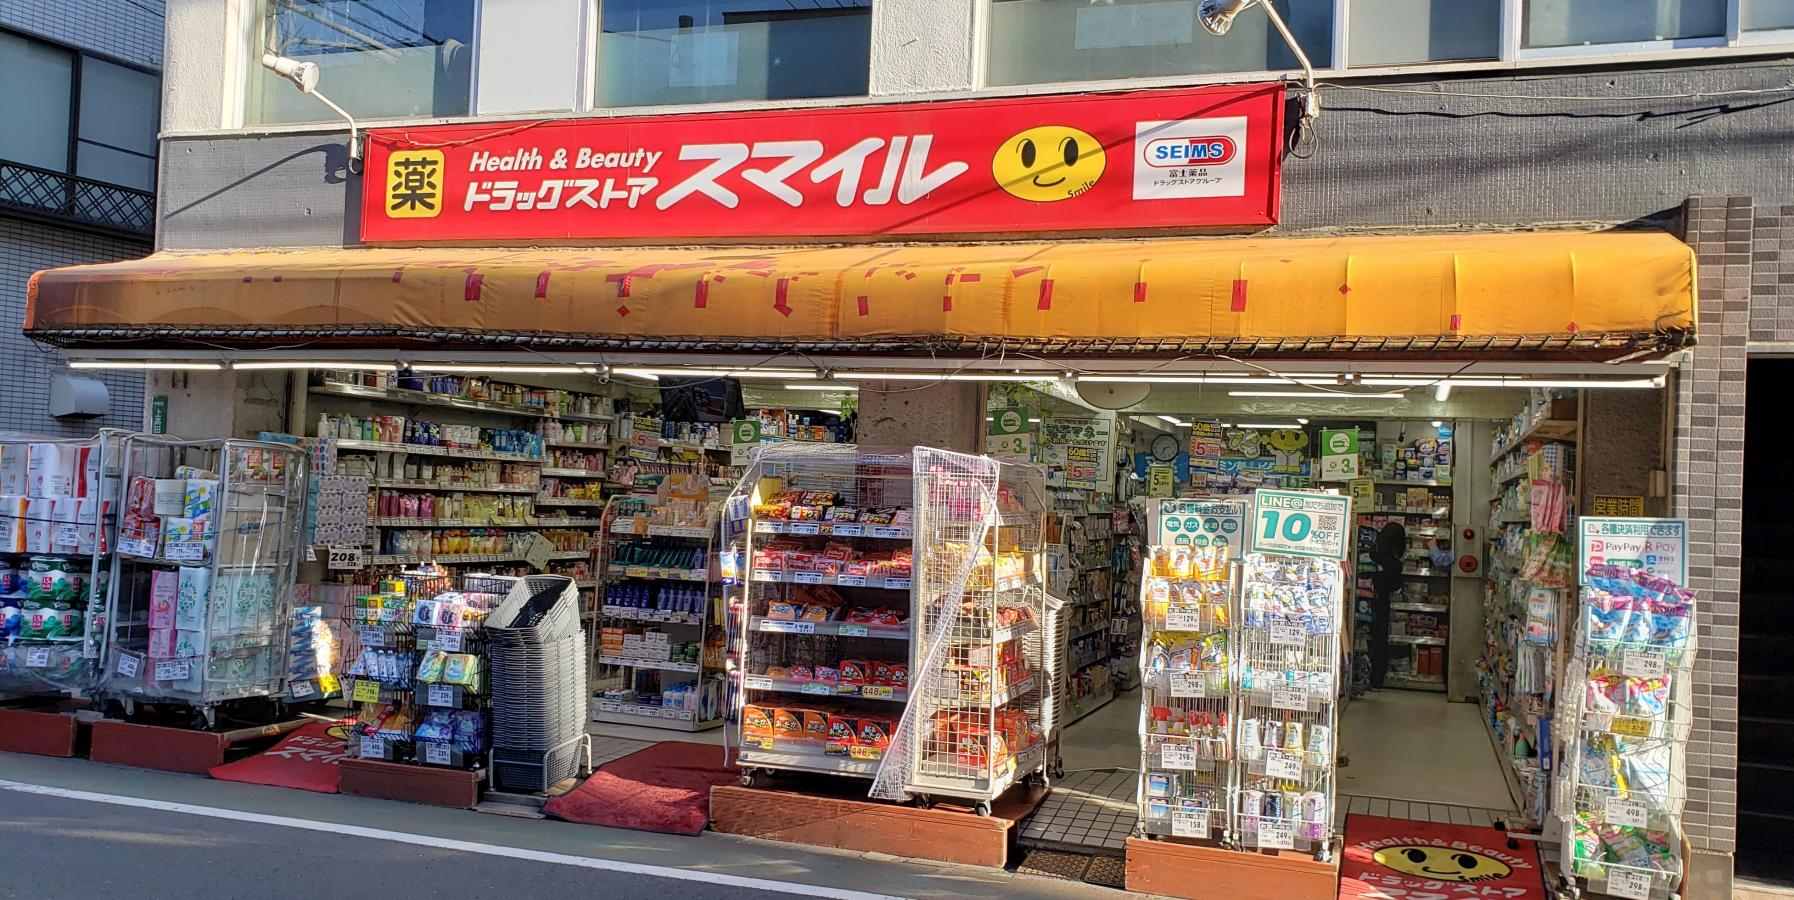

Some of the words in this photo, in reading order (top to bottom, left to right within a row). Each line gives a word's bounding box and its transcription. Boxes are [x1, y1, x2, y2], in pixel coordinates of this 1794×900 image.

[1155, 142, 1224, 160] SEIMS
[469, 147, 543, 173] Health
[549, 148, 568, 169] &
[574, 146, 663, 173] Beauty
[655, 134, 969, 210] スマイル
[1168, 168, 1209, 178] 富士薬品
[391, 157, 438, 211] 薬
[1153, 177, 1223, 187] ドラッグストアグループ
[464, 176, 659, 212] ドラッグストア
[1067, 178, 1095, 199] Smile
[1261, 496, 1304, 510] LINE@
[1595, 496, 1641, 517] 営業時間
[1262, 511, 1311, 542] 10
[1602, 523, 1681, 536] 各種決済利用できます
[1311, 530, 1340, 541] %OFF
[1605, 541, 1642, 553] PayPay
[1655, 541, 1677, 553] Pay
[331, 553, 355, 562] 208
[863, 687, 879, 696] 448
[1179, 753, 1190, 761] 298
[1284, 762, 1297, 770] 249
[1626, 809, 1640, 817] 498
[1276, 831, 1288, 839] 249
[1354, 836, 1431, 851] Health
[1431, 838, 1450, 847] &
[1451, 840, 1534, 870] Beauty
[1458, 873, 1503, 883] Smile
[1358, 871, 1528, 898] ドラッグストア
[1629, 881, 1643, 889] 298
